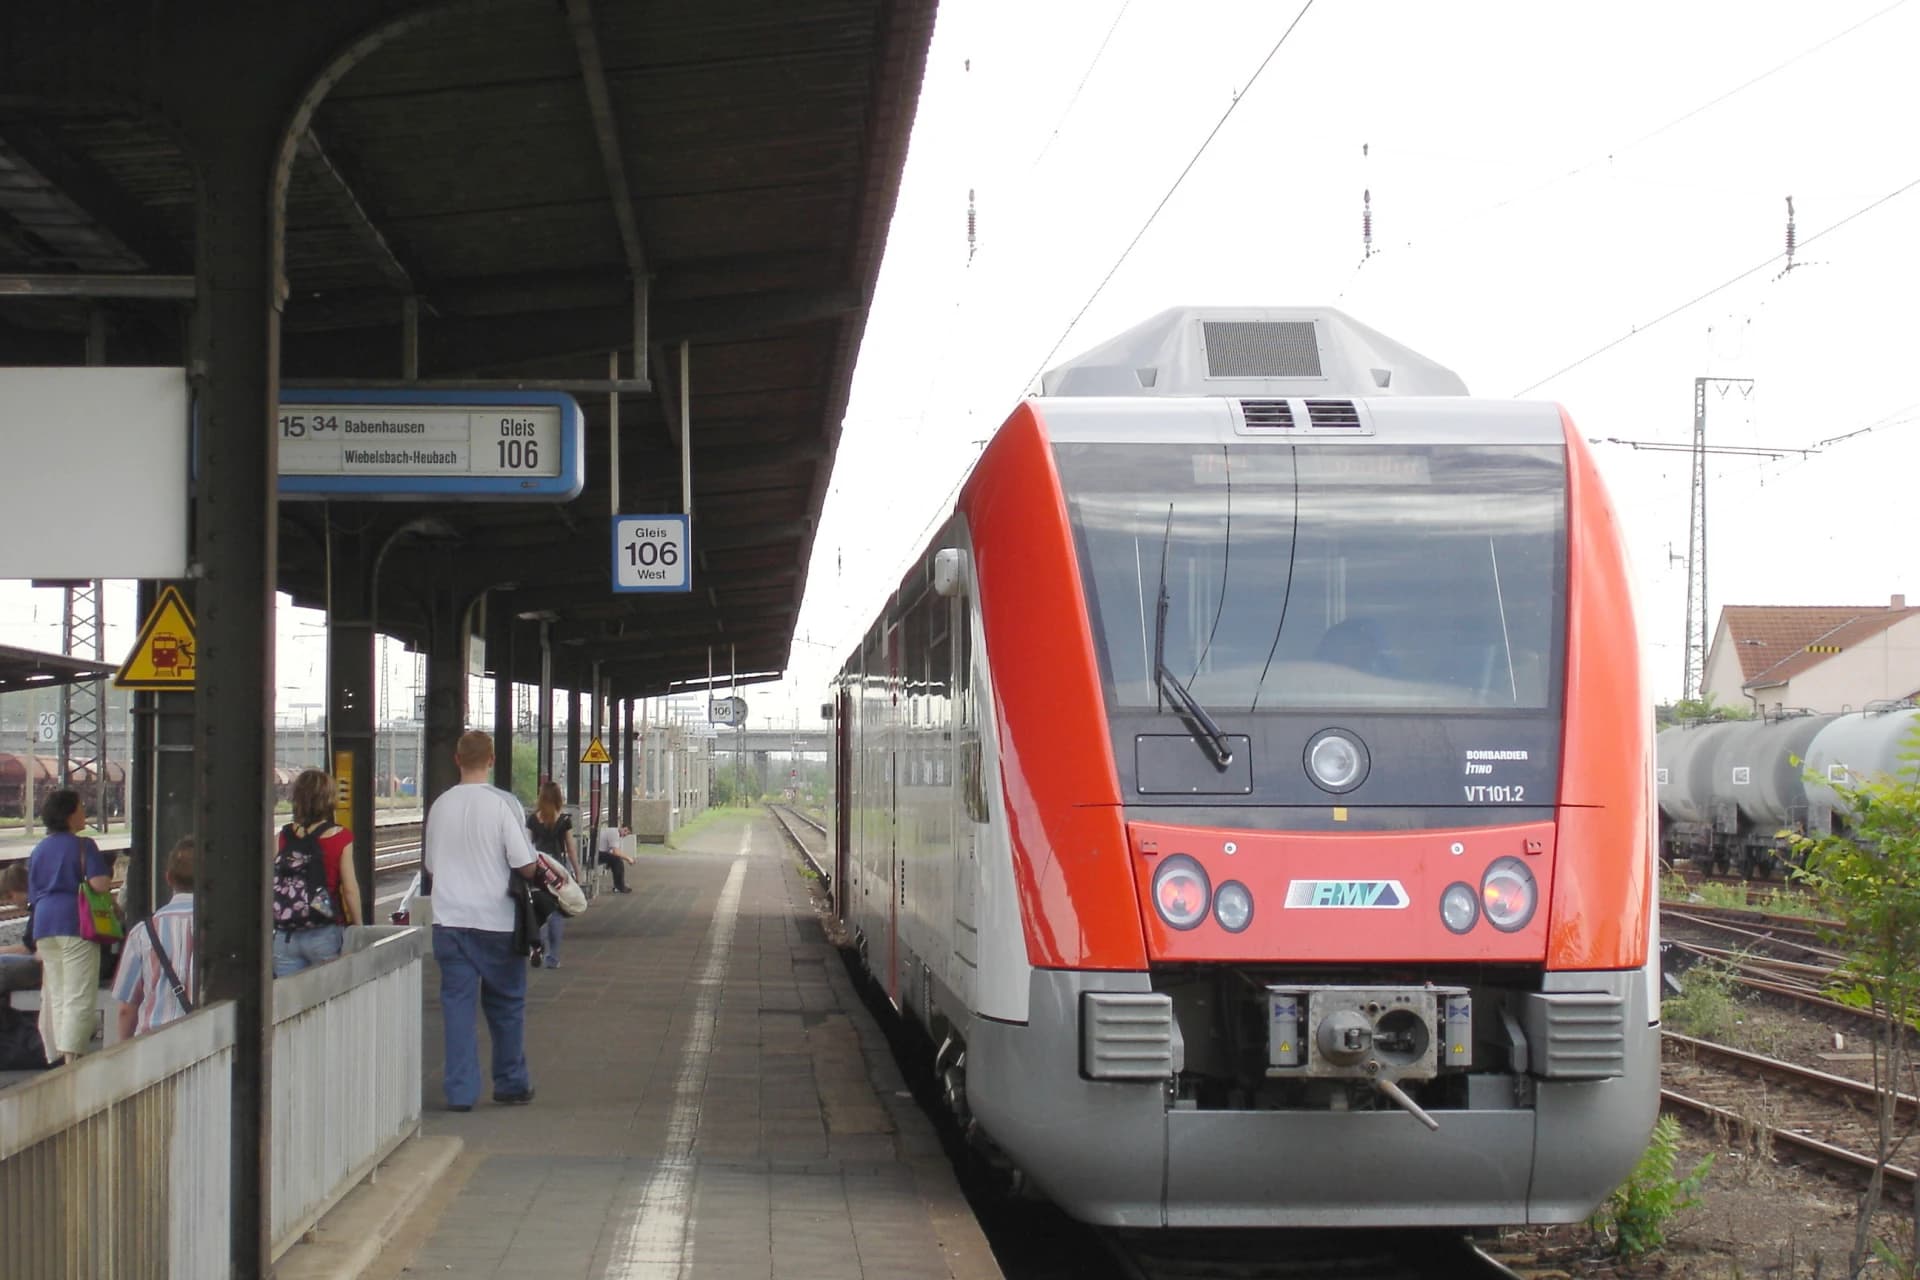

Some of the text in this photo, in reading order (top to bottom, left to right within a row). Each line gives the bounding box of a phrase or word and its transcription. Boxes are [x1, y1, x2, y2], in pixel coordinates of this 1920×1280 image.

[280, 416, 425, 437] 15 34 Babenhausen
[501, 418, 535, 437] Gleis
[497, 440, 538, 469] 106
[635, 528, 667, 538] Gleis
[625, 541, 678, 566] 106
[637, 569, 666, 579] West
[714, 706, 731, 716] 106
[40, 713, 57, 726] 20
[1466, 750, 1529, 760] BOMBARDIER
[1464, 785, 1525, 802] VT101.2
